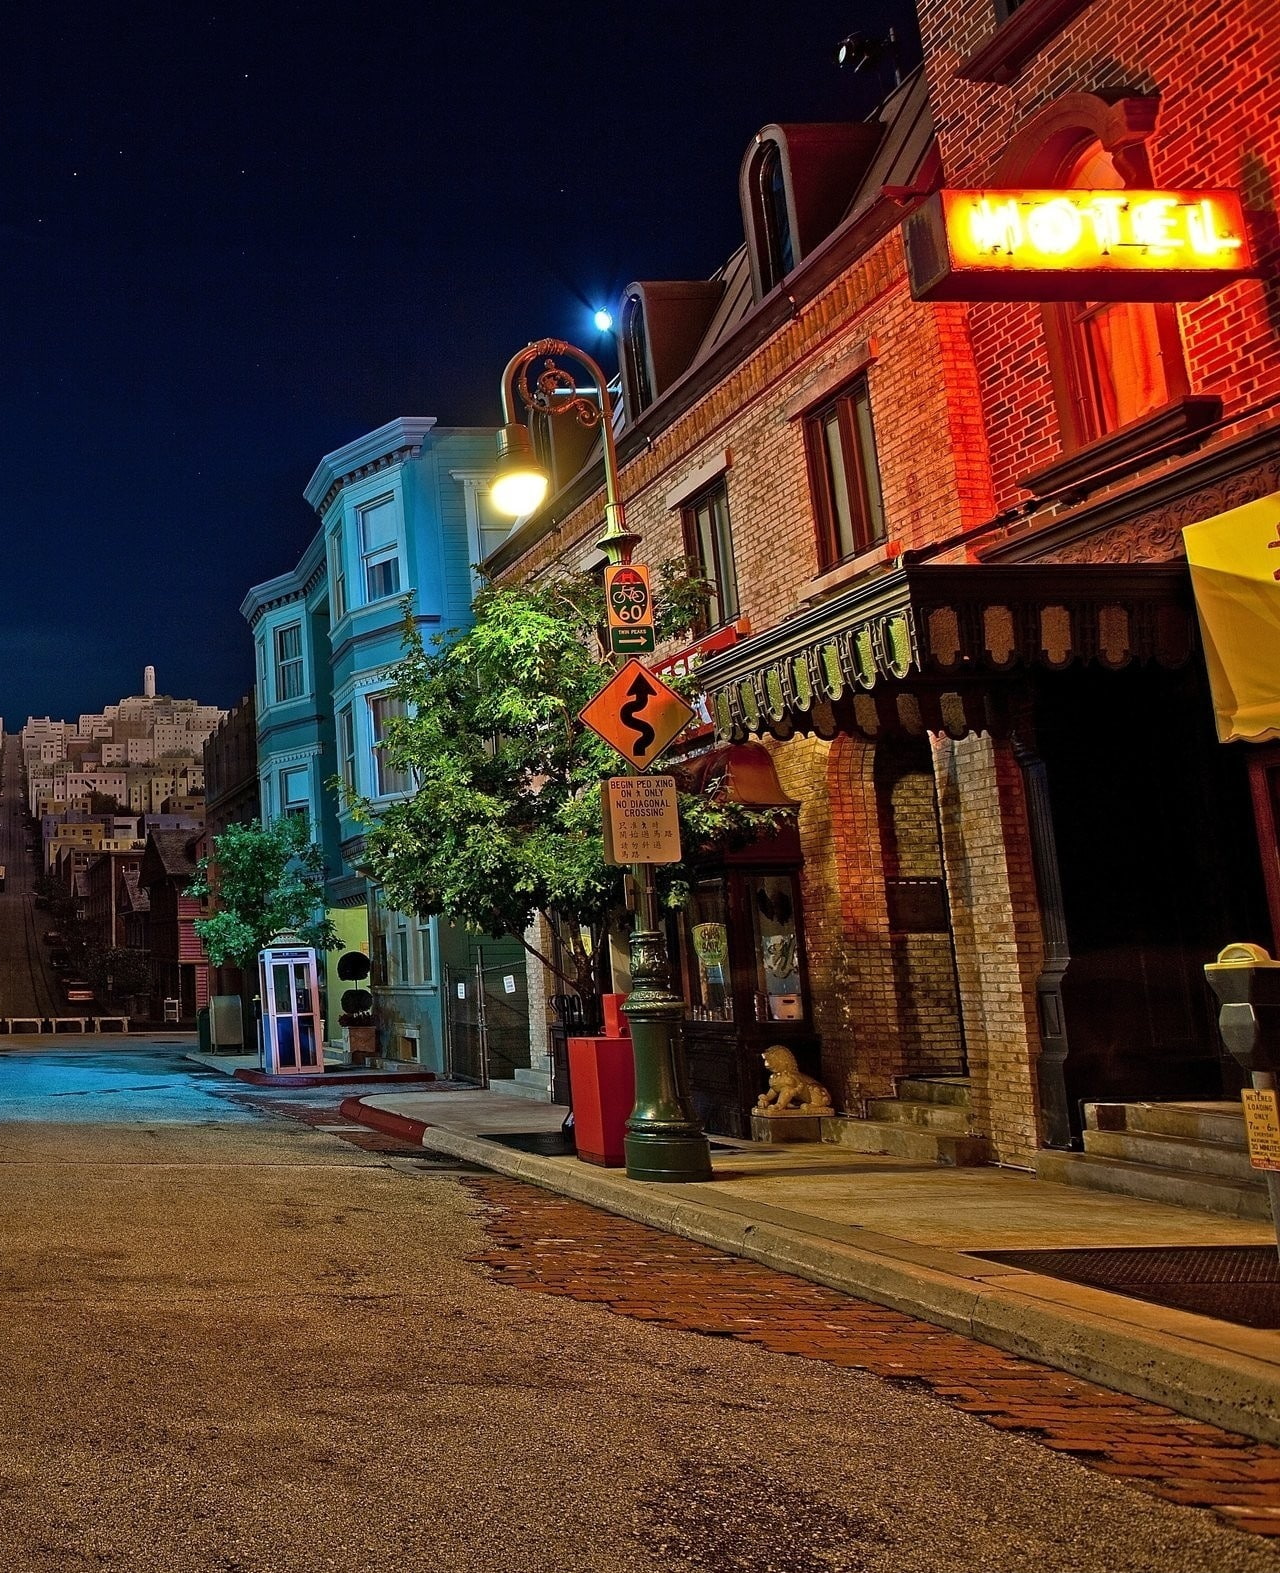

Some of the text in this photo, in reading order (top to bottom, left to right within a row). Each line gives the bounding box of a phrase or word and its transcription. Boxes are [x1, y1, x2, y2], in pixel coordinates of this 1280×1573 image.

[619, 605, 642, 620] 60
[611, 779, 673, 789] BEGIN PED XING
[621, 789, 664, 798] ON ONLY
[616, 799, 670, 808] NO DIAGONAL
[624, 809, 664, 817] CROSSING
[1245, 1094, 1273, 1103] METERED
[1247, 1104, 1273, 1112] LOADING
